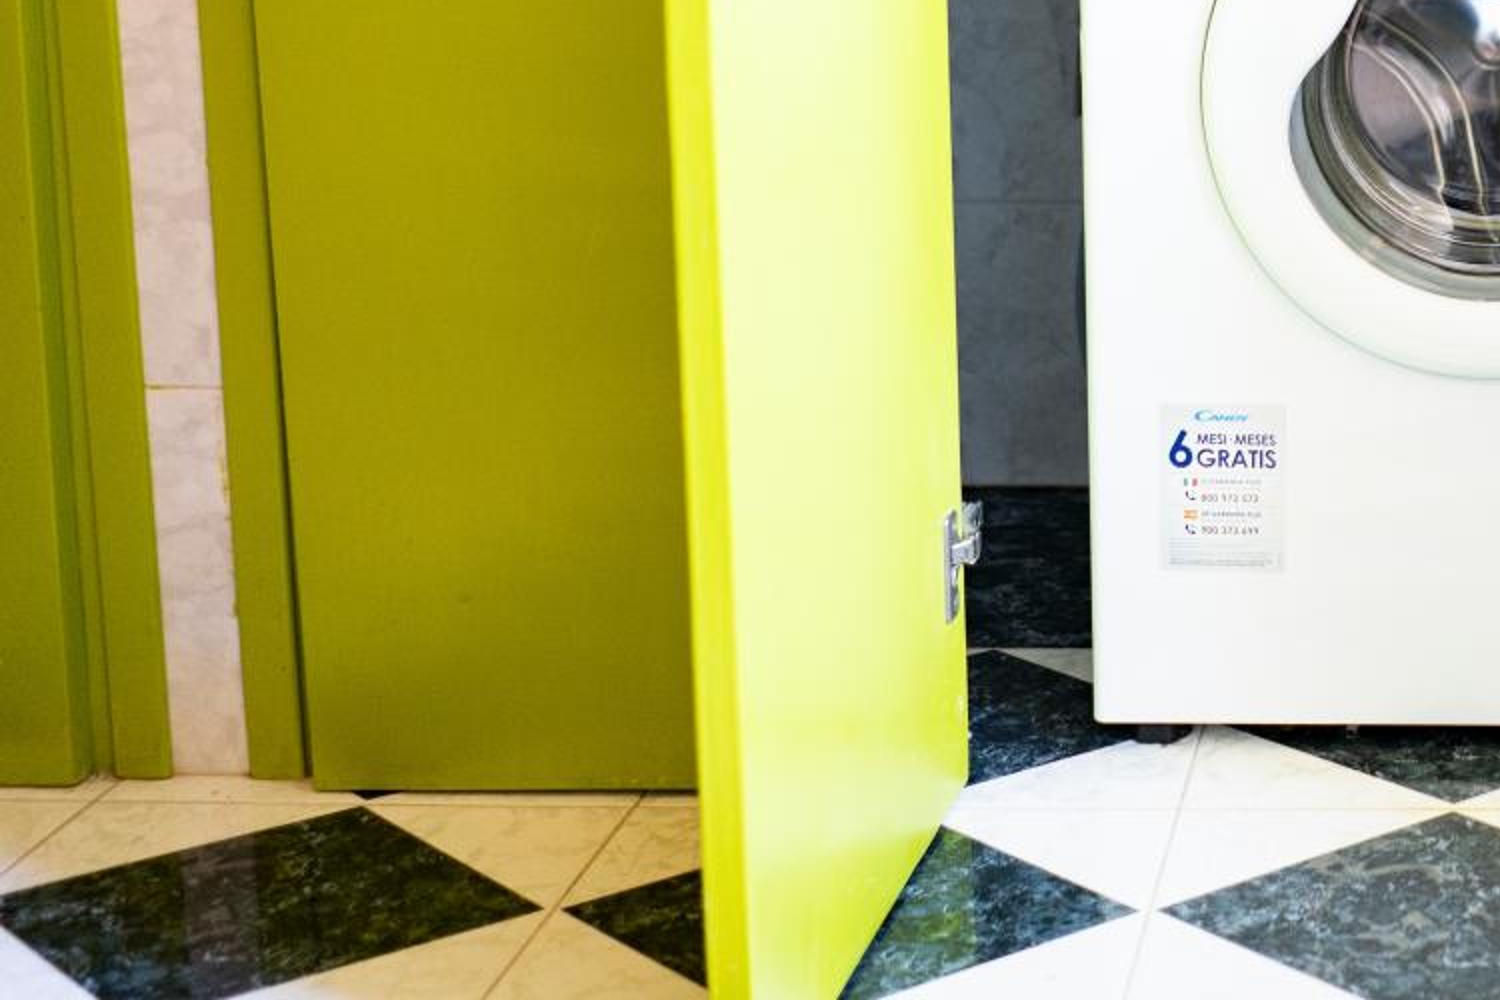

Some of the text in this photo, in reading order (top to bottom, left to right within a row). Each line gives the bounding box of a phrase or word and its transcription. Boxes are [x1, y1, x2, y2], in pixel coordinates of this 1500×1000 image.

[1168, 429, 1193, 469] 6
[1196, 433, 1277, 446] MESI MESES
[1197, 449, 1277, 469] GRATIS
